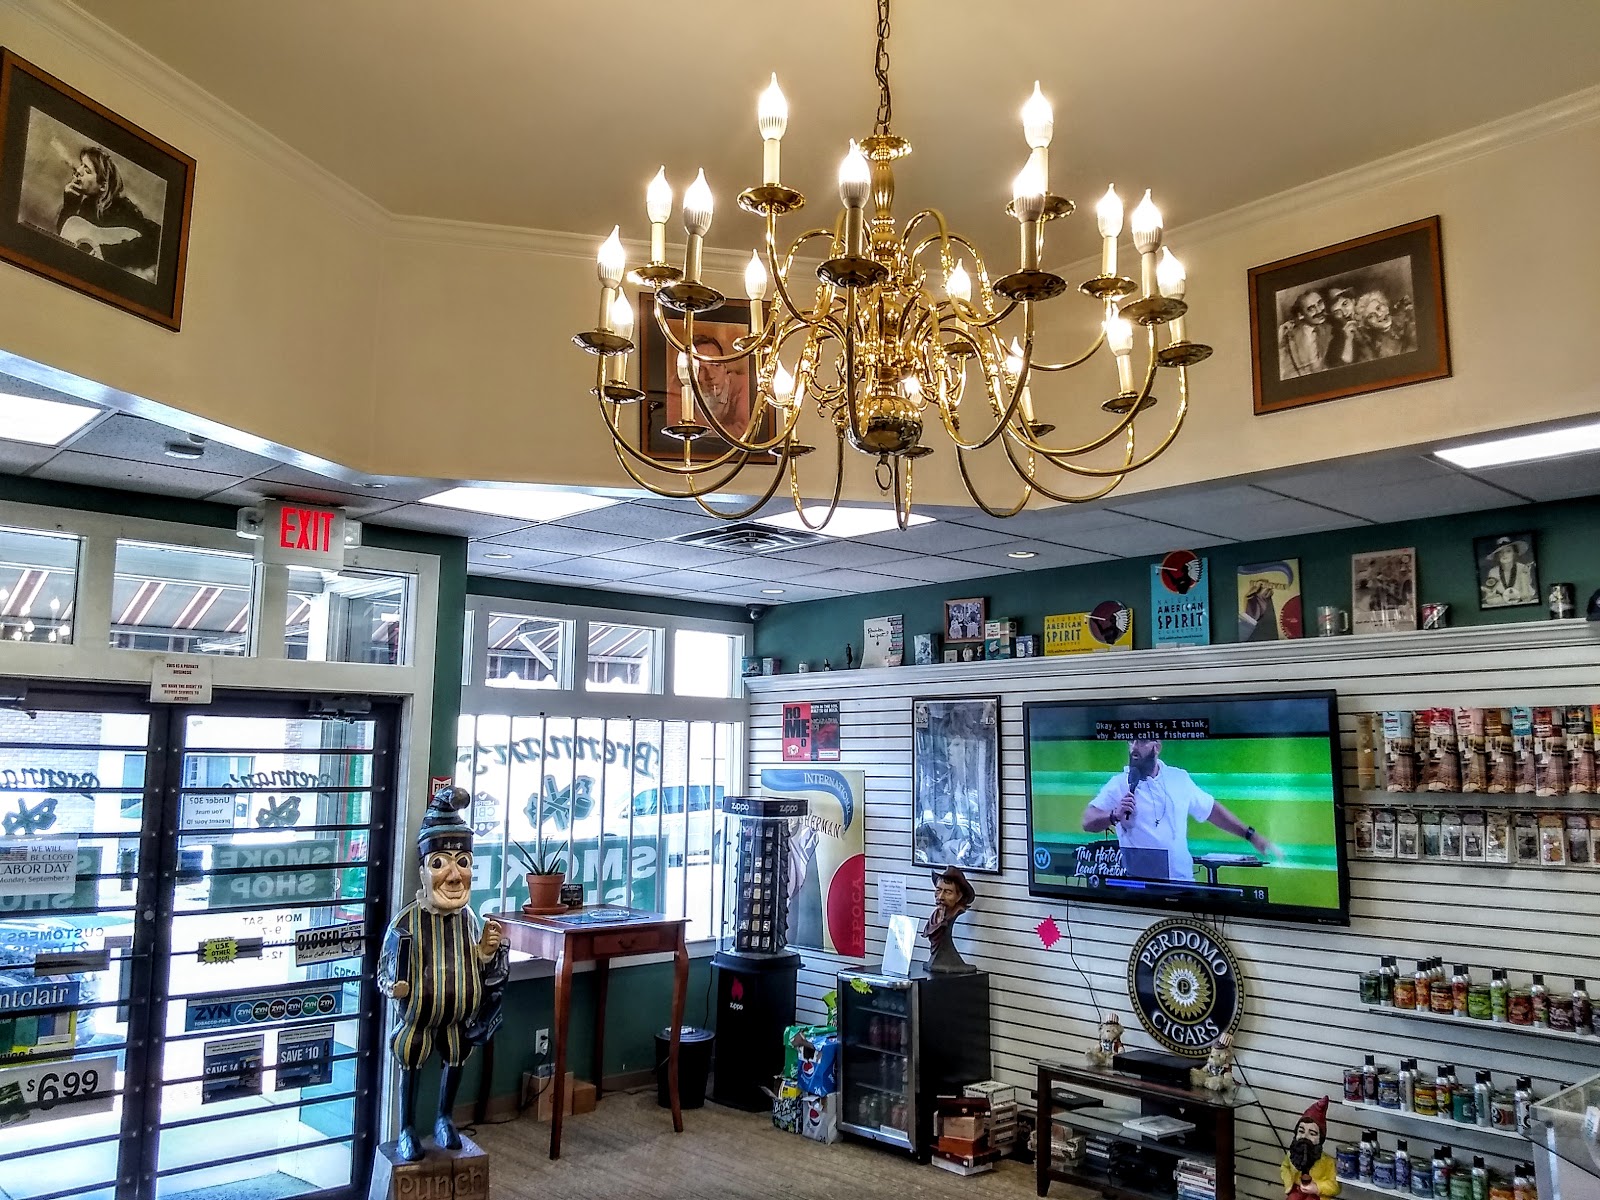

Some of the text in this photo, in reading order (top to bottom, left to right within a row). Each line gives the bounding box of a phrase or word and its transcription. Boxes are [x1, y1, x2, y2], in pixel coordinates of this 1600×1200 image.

[280, 506, 335, 553] EXIT
[1157, 602, 1203, 614] AMERICAN
[1047, 621, 1082, 630] AMERICAN
[1157, 612, 1203, 630] SPIRIT
[1047, 629, 1082, 643] SPIRIT
[1096, 722, 1117, 731] Okay,
[1133, 721, 1151, 729] this
[1155, 720, 1168, 729] is,
[1172, 720, 1177, 728] I
[1181, 720, 1209, 729] think,
[1137, 731, 1160, 739] calls
[434, 783, 451, 793] FIR
[804, 772, 852, 815] INTERNATIONAL
[731, 802, 750, 812] zippo
[780, 804, 799, 814] zippo
[800, 813, 842, 839] HERMAN
[1075, 846, 1092, 862] Tim
[0, 864, 41, 875] ABOR
[45, 863, 70, 874] DAY
[1074, 861, 1127, 877] Lead Pastor
[1253, 889, 1265, 900] 18
[851, 877, 864, 949] EPOCA
[298, 930, 340, 951] CLOSED
[211, 949, 231, 957] OTHER
[1140, 930, 1228, 976] PERDOMO
[1181, 980, 1189, 993] P
[0, 985, 70, 1009] ntclair
[195, 1004, 232, 1022] ZYN
[237, 1008, 251, 1016] ZYN
[254, 1006, 268, 1014] ZYN
[271, 1004, 285, 1012] ZYN
[1152, 1011, 1220, 1045] CIGARS
[281, 1049, 304, 1064] SAVE
[305, 1046, 319, 1060] $10
